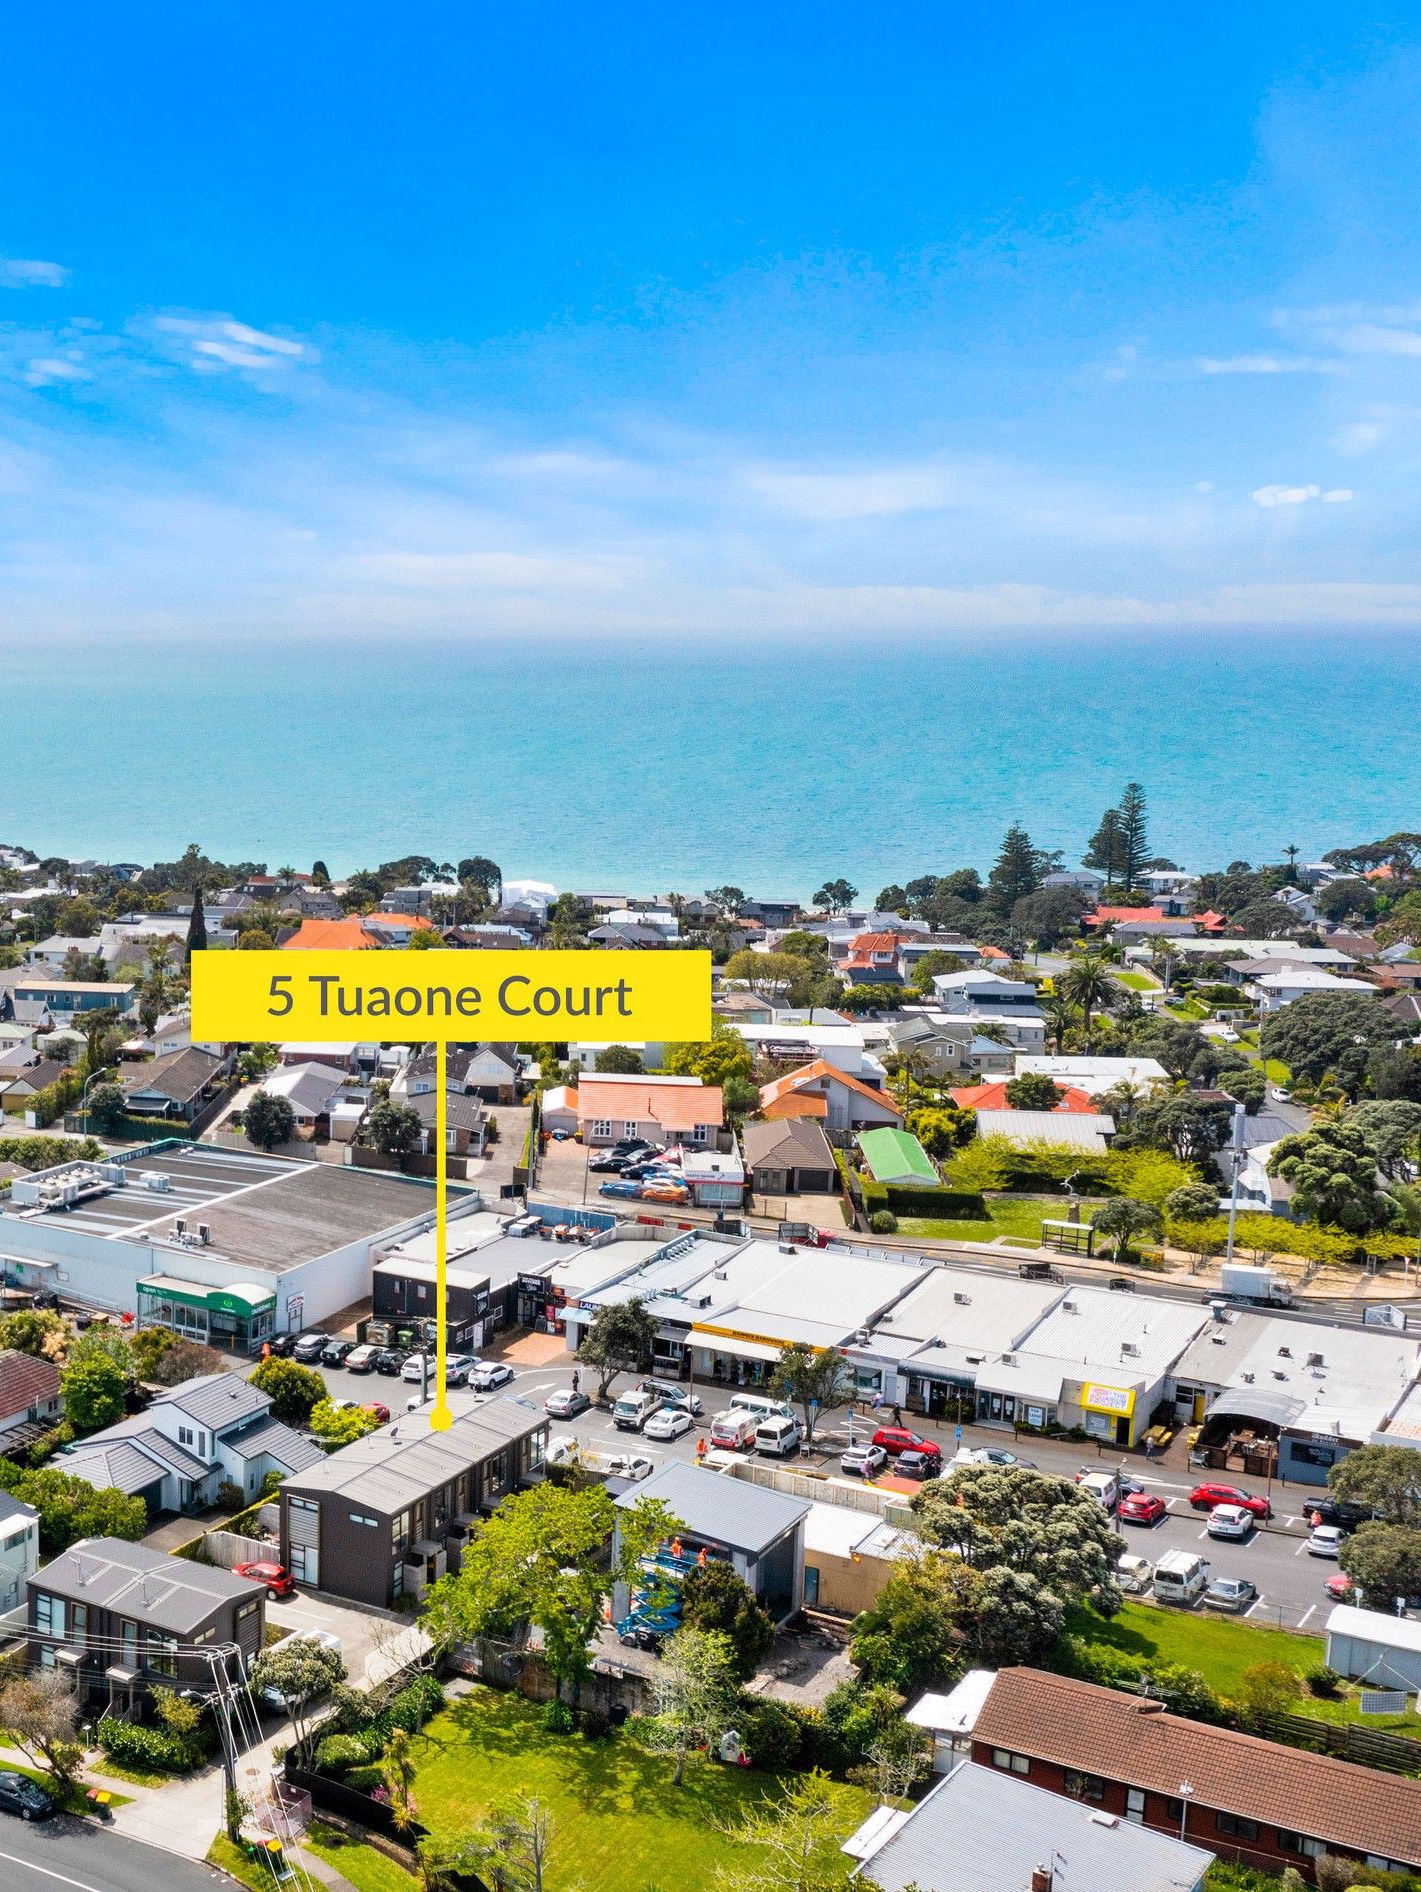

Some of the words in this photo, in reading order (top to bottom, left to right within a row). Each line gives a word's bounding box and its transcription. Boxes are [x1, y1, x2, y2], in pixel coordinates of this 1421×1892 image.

[142, 1286, 157, 1294] open
[1089, 1398, 1125, 1409] PROJECT
[1090, 1393, 1127, 1404] AQUARIUM
